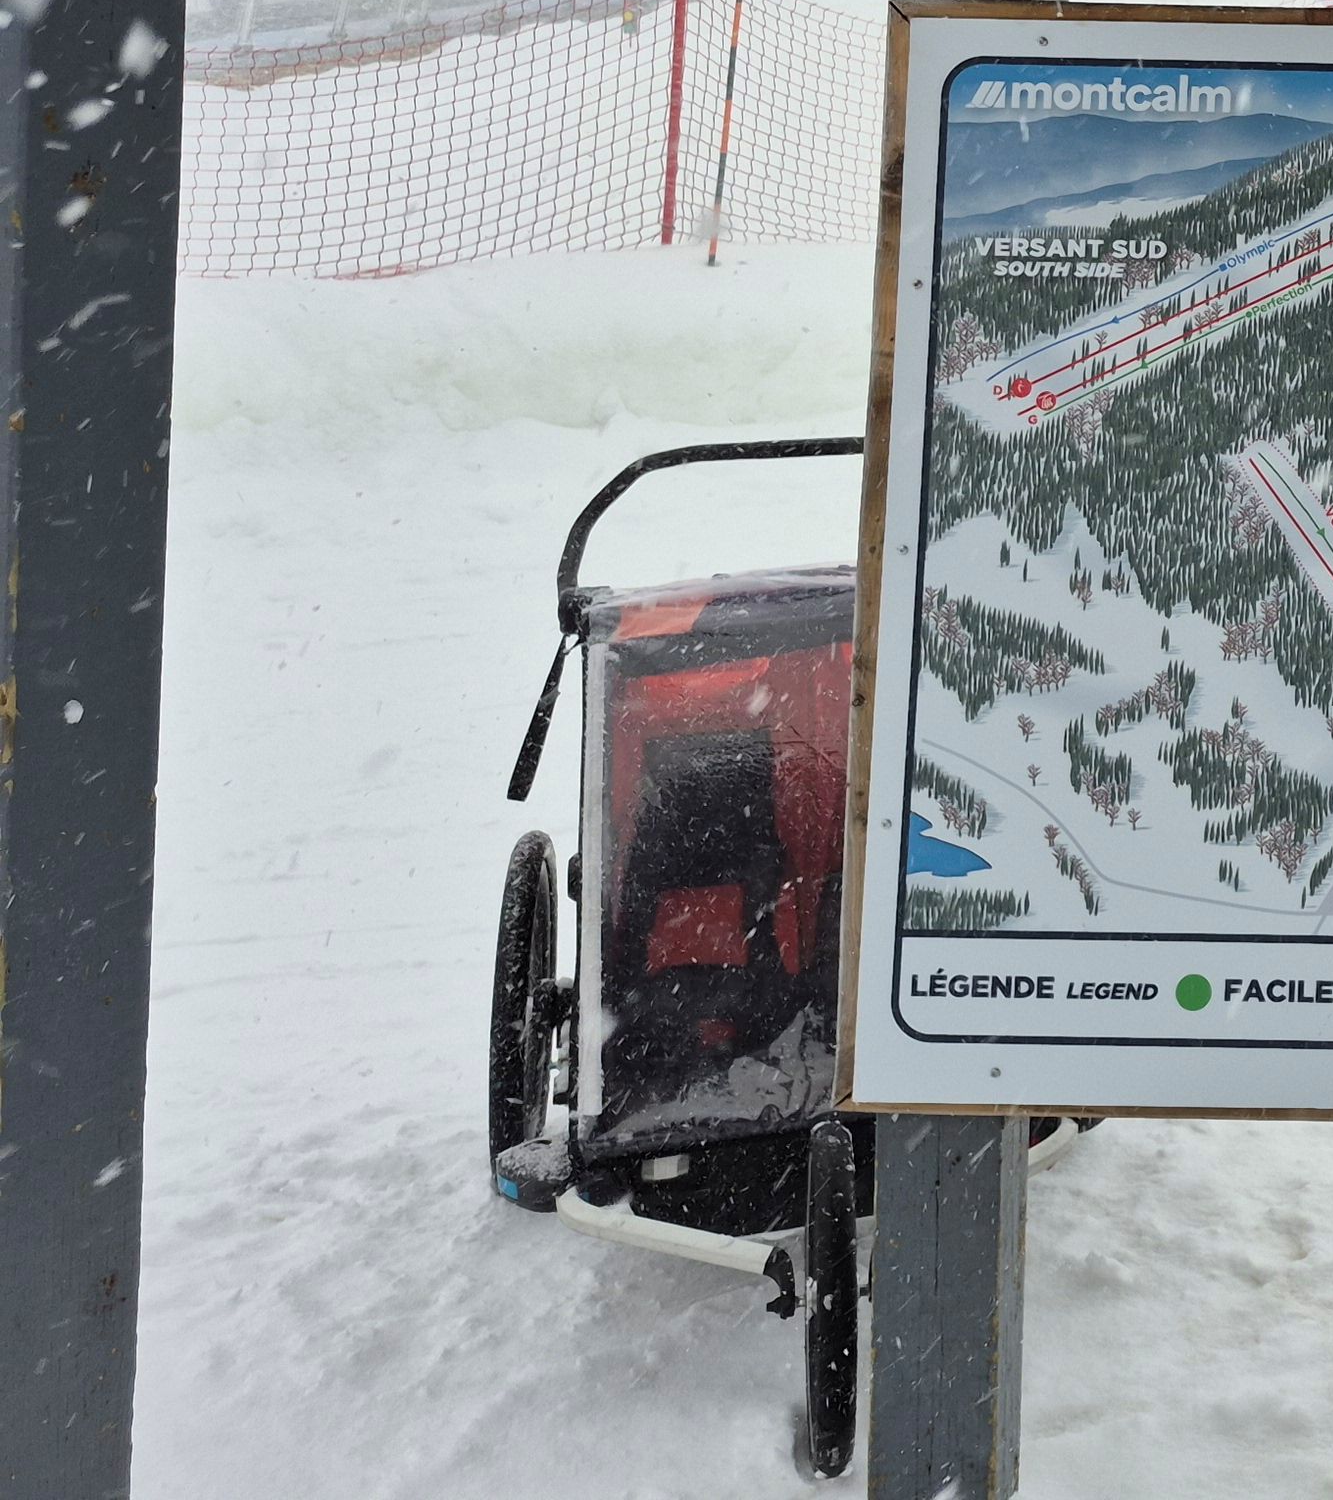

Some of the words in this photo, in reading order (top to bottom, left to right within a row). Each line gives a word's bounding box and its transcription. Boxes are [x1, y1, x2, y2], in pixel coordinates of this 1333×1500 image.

[1010, 75, 1232, 113] montcalm
[975, 237, 1104, 258] VERSANT
[1112, 240, 1168, 260] SUD
[1227, 238, 1275, 271] Olympic
[993, 260, 1071, 277] SOUTH
[1073, 262, 1126, 279] SIDE
[1251, 281, 1313, 317] Perfection
[911, 968, 1055, 999] LÉGENDE
[1066, 982, 1158, 1000] LEGEND
[1224, 979, 1333, 1003] FACILE
